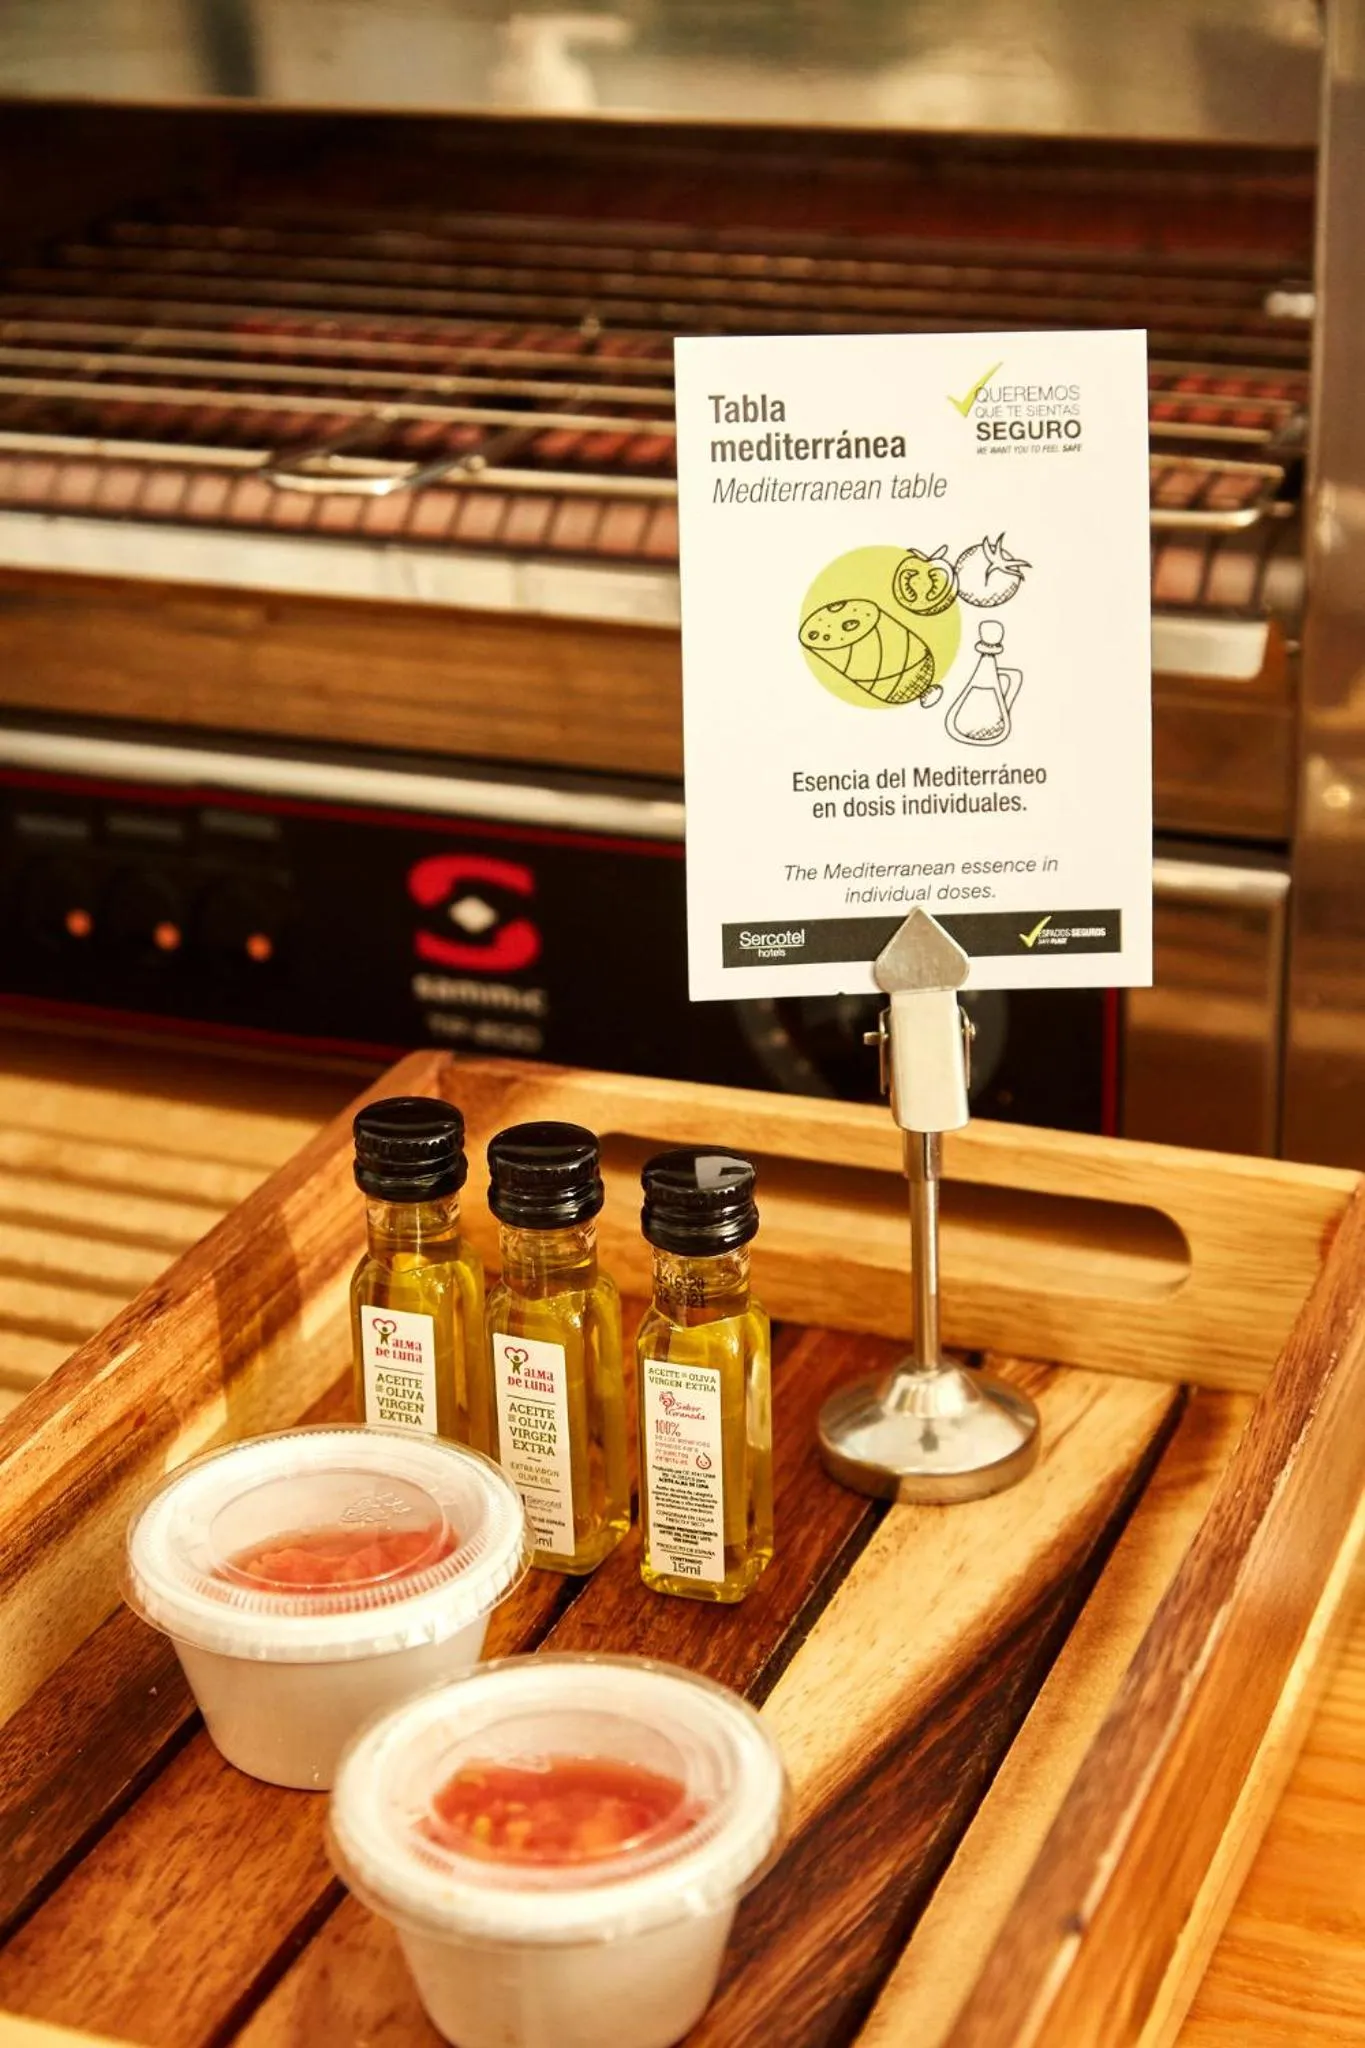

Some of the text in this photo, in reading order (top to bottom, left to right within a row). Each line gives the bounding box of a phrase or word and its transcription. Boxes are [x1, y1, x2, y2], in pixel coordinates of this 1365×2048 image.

[974, 384, 1081, 404] QUEREMOS
[708, 394, 786, 424] Tabla
[975, 404, 1080, 419] QUE TE SIENTAS
[976, 419, 1082, 441] SEGURO
[710, 429, 907, 463] mediterránea
[990, 445, 1012, 454] WANT
[1014, 445, 1029, 454] YOU
[1031, 444, 1041, 453] TO
[713, 472, 948, 504] Mediterranean table
[792, 763, 1048, 792] Esencia del Mediterráneo
[812, 792, 1028, 818] en dosis individuales.
[785, 856, 1059, 882] The Mediterranean essence in
[844, 883, 997, 904] individual doses.
[739, 928, 805, 947] Sercotel
[758, 948, 786, 958] hotels
[376, 1373, 423, 1390] ACEITE
[648, 1368, 680, 1379] ACEITE
[688, 1373, 716, 1384] OLIVA
[649, 1376, 682, 1389] VIRGEN
[685, 1382, 716, 1393] EXTRA
[385, 1386, 424, 1402] OLIVA
[376, 1396, 424, 1414] VIRGEN
[509, 1402, 555, 1420] ACEITE
[379, 1408, 423, 1426] EXTRA
[518, 1416, 557, 1432] OLIVA
[509, 1426, 557, 1444] VIRGEN
[655, 1419, 681, 1437] 100%
[512, 1438, 556, 1457] EXTRA
[673, 1561, 701, 1576] 15ml
